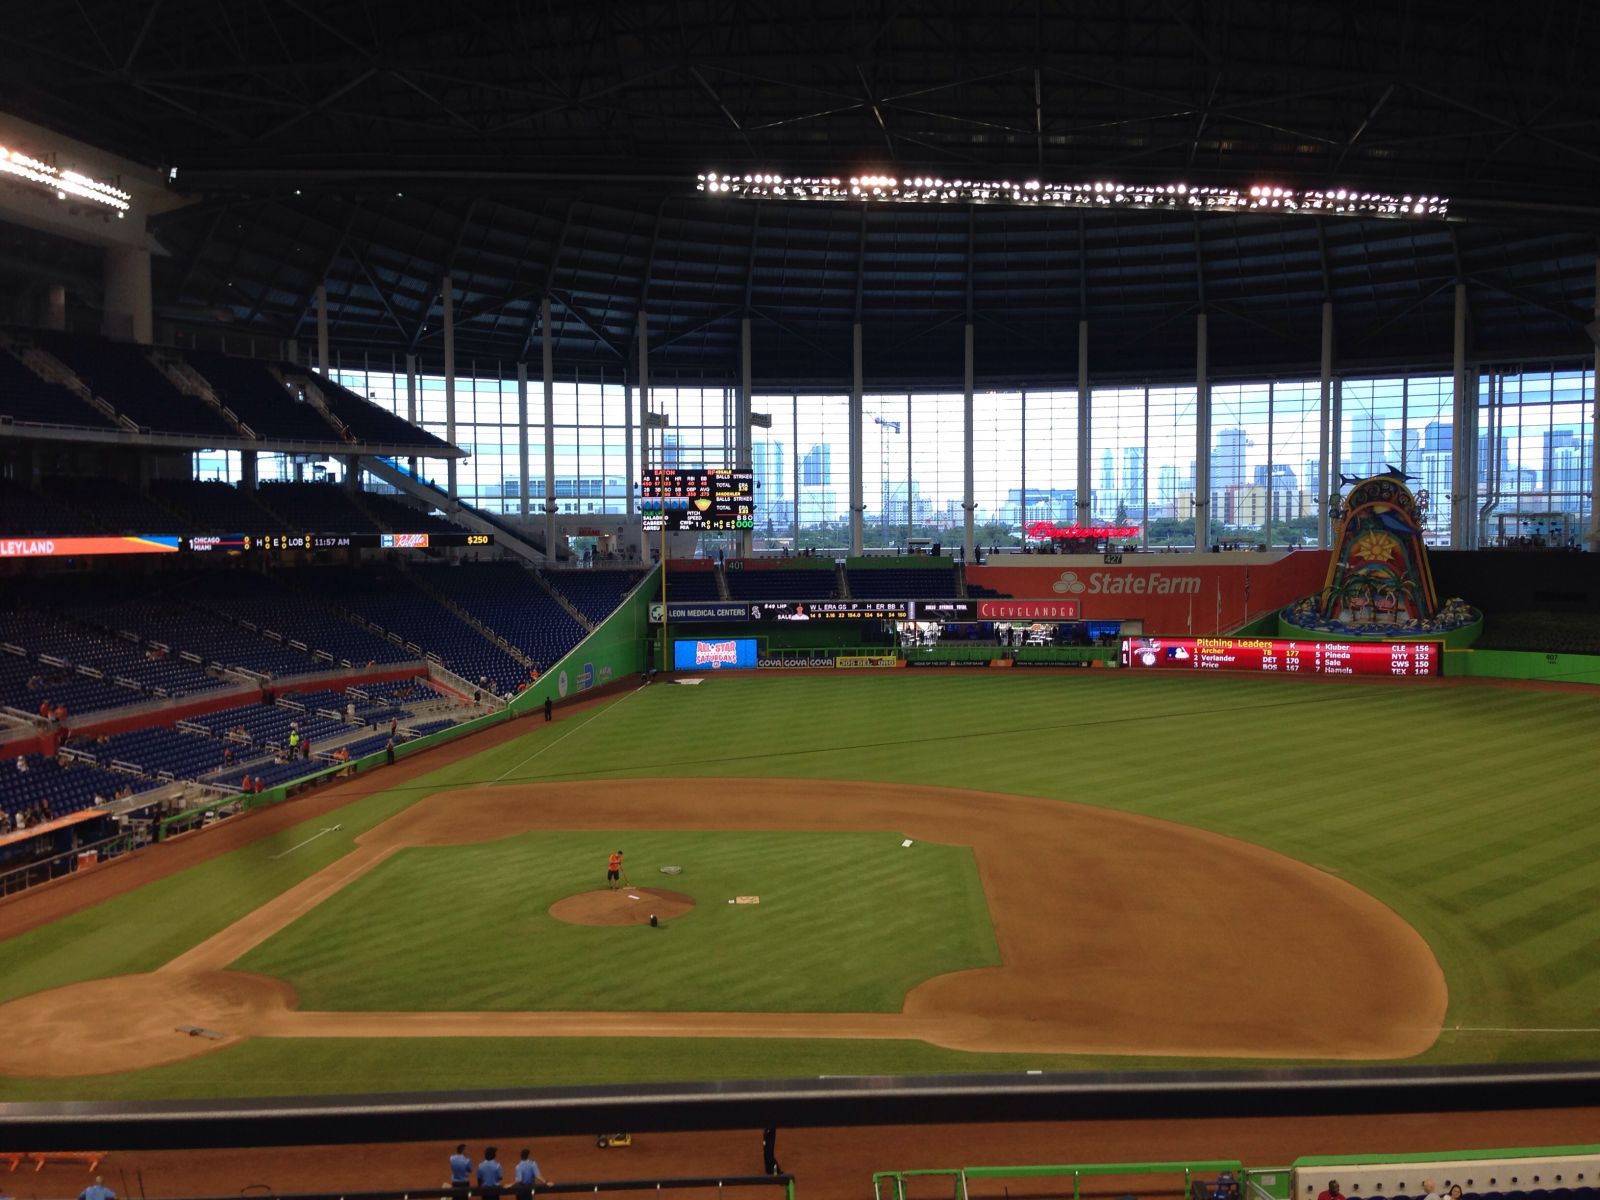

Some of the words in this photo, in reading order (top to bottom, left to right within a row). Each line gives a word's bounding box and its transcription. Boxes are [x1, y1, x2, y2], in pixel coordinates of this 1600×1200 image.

[189, 539, 193, 550] 1
[194, 536, 220, 544] CHICAGO
[256, 539, 263, 547] H
[273, 538, 279, 546] E
[288, 538, 304, 547] LOB
[315, 538, 336, 546] 11:57
[337, 538, 350, 546] AM
[467, 536, 488, 546] $250
[0, 540, 55, 555] LEYLAND
[729, 561, 744, 569] 401
[687, 609, 716, 617] MEDICAL
[717, 608, 746, 616] CENTERS
[982, 603, 1075, 617] CLEVELANDER
[1196, 639, 1233, 649] Pitching
[1238, 639, 1273, 648] Leaders
[1325, 643, 1350, 651] Kluber
[696, 654, 738, 664] SATURDAYS
[1325, 651, 1351, 659] Pineda
[758, 659, 782, 667] GOYA
[784, 659, 808, 667] GOYA
[809, 658, 833, 666] GOYA
[1201, 661, 1219, 669] Price
[1325, 666, 1353, 674] Hamels
